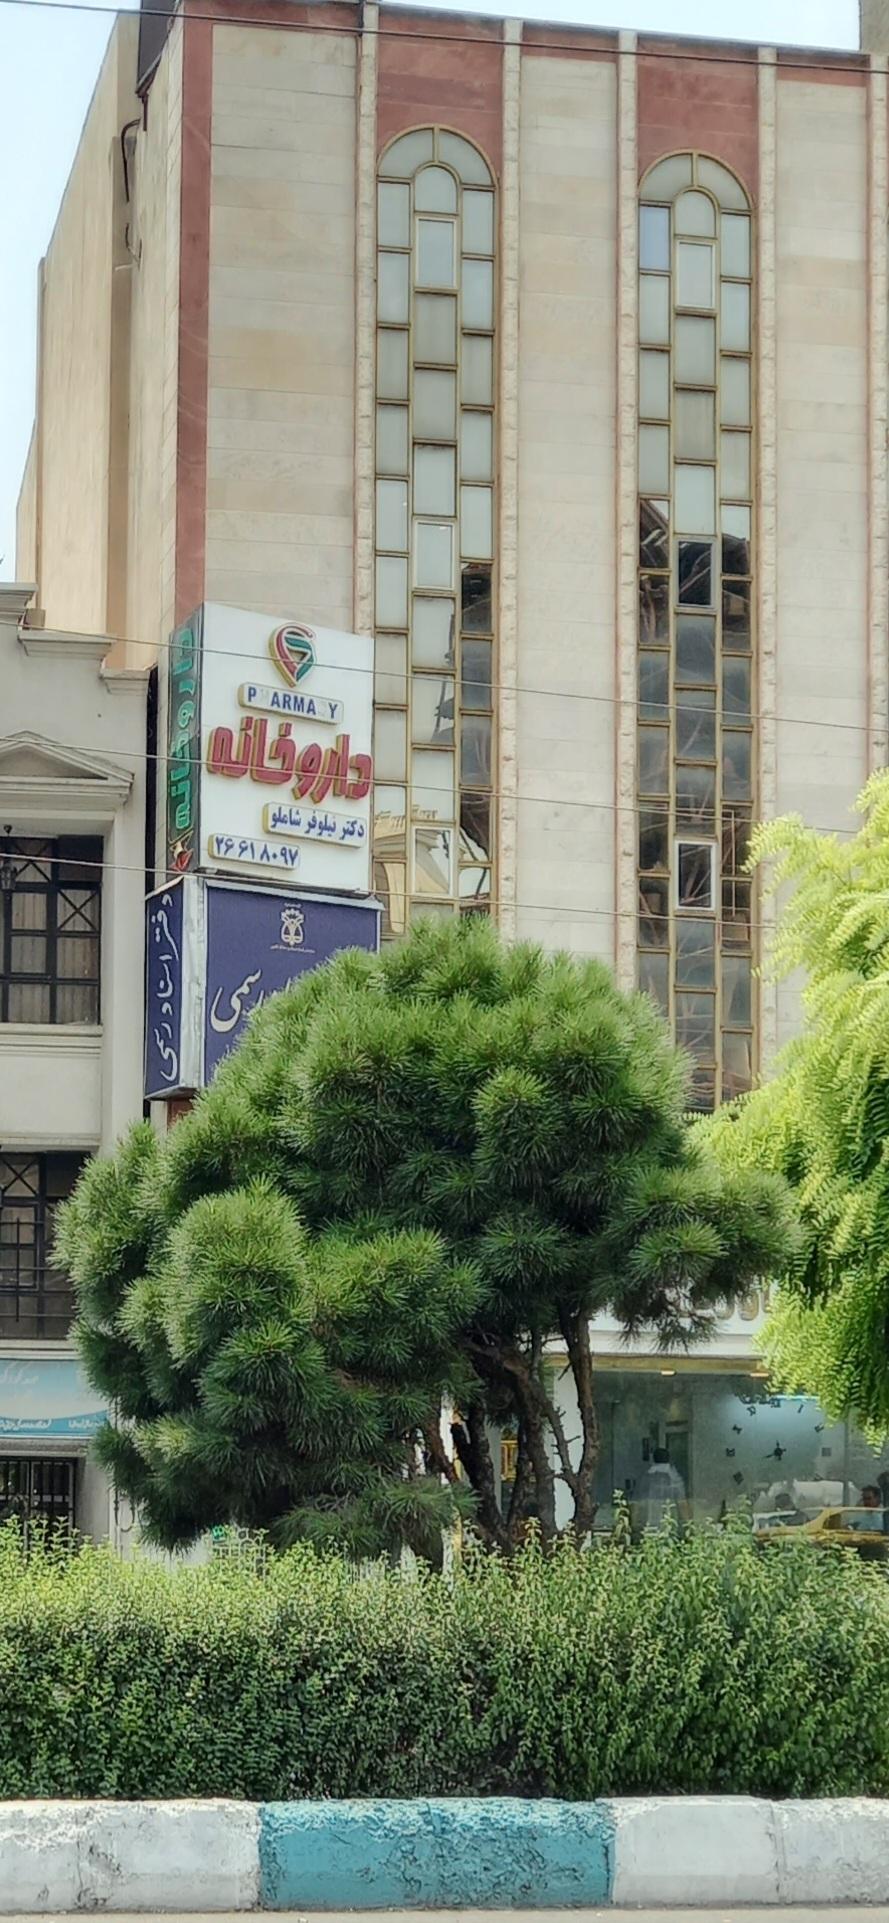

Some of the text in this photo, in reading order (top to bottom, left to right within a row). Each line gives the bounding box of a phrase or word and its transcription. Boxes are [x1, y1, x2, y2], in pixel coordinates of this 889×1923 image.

[170, 627, 196, 830] داروخانه
[247, 685, 339, 719] PARMAY
[208, 716, 372, 803] داروخانه
[270, 806, 365, 840] دکتر نیلوفر شاملو
[151, 893, 179, 961] دفتر
